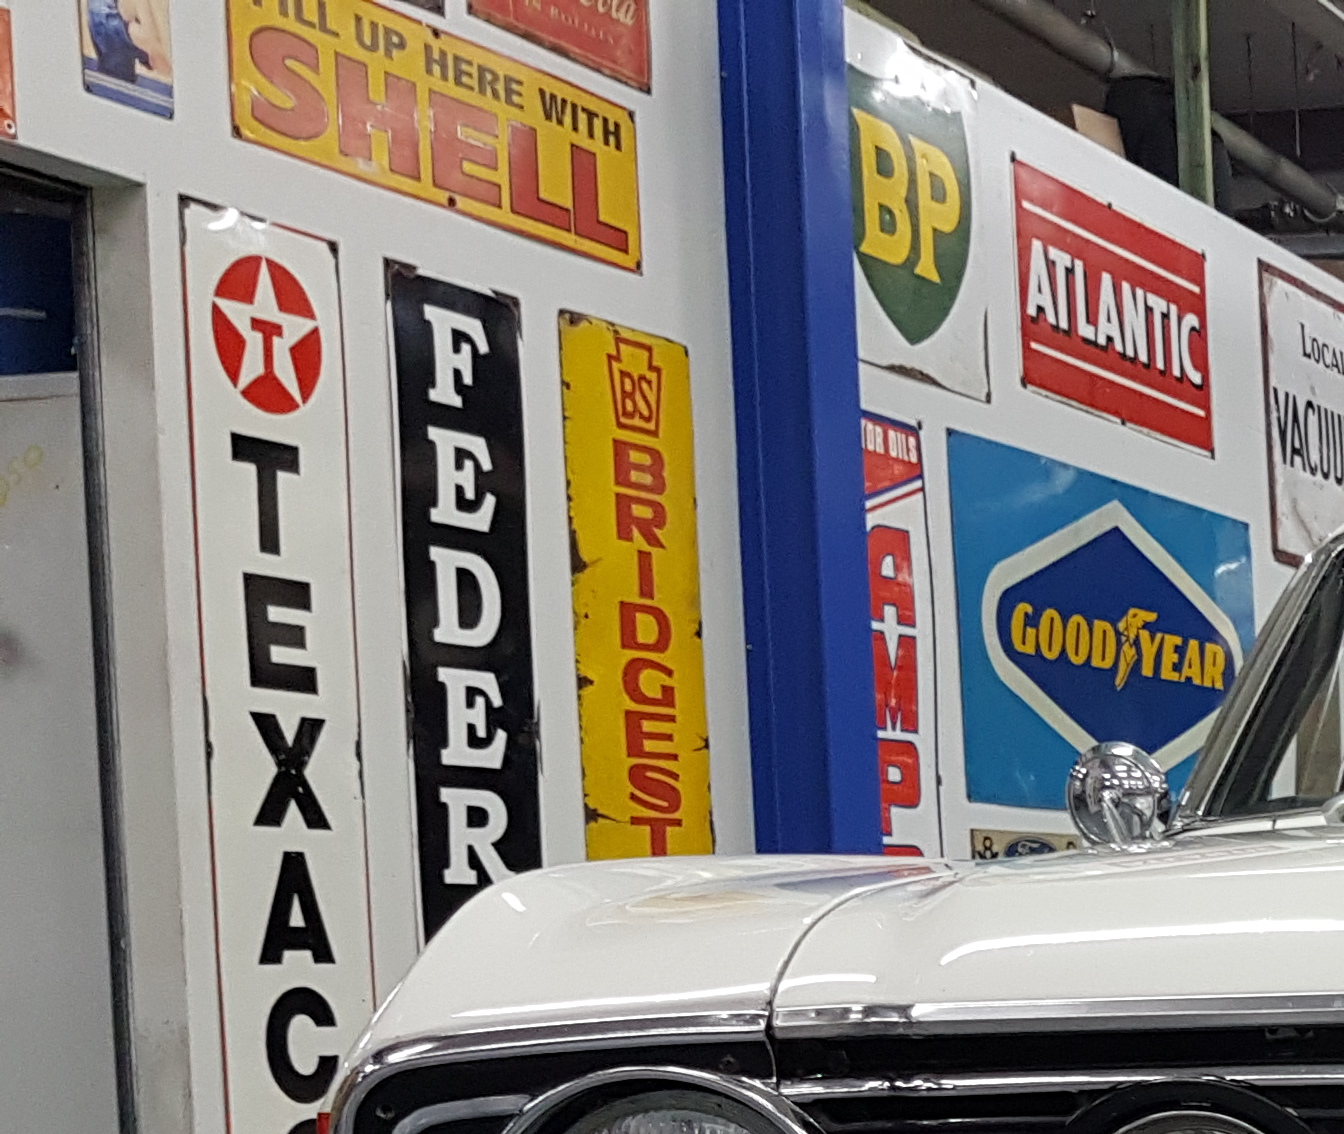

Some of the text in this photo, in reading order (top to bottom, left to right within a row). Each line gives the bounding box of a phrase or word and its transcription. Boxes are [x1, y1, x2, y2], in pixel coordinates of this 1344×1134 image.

[248, 25, 630, 255] SHELL
[353, 12, 408, 61] UP
[424, 43, 525, 111] HERE
[538, 87, 622, 152] WITH
[853, 107, 961, 284] BP
[1026, 237, 1204, 388] ATLANTIC
[617, 371, 659, 424] BS
[861, 418, 918, 464] OR OILS
[867, 525, 925, 857] AMP
